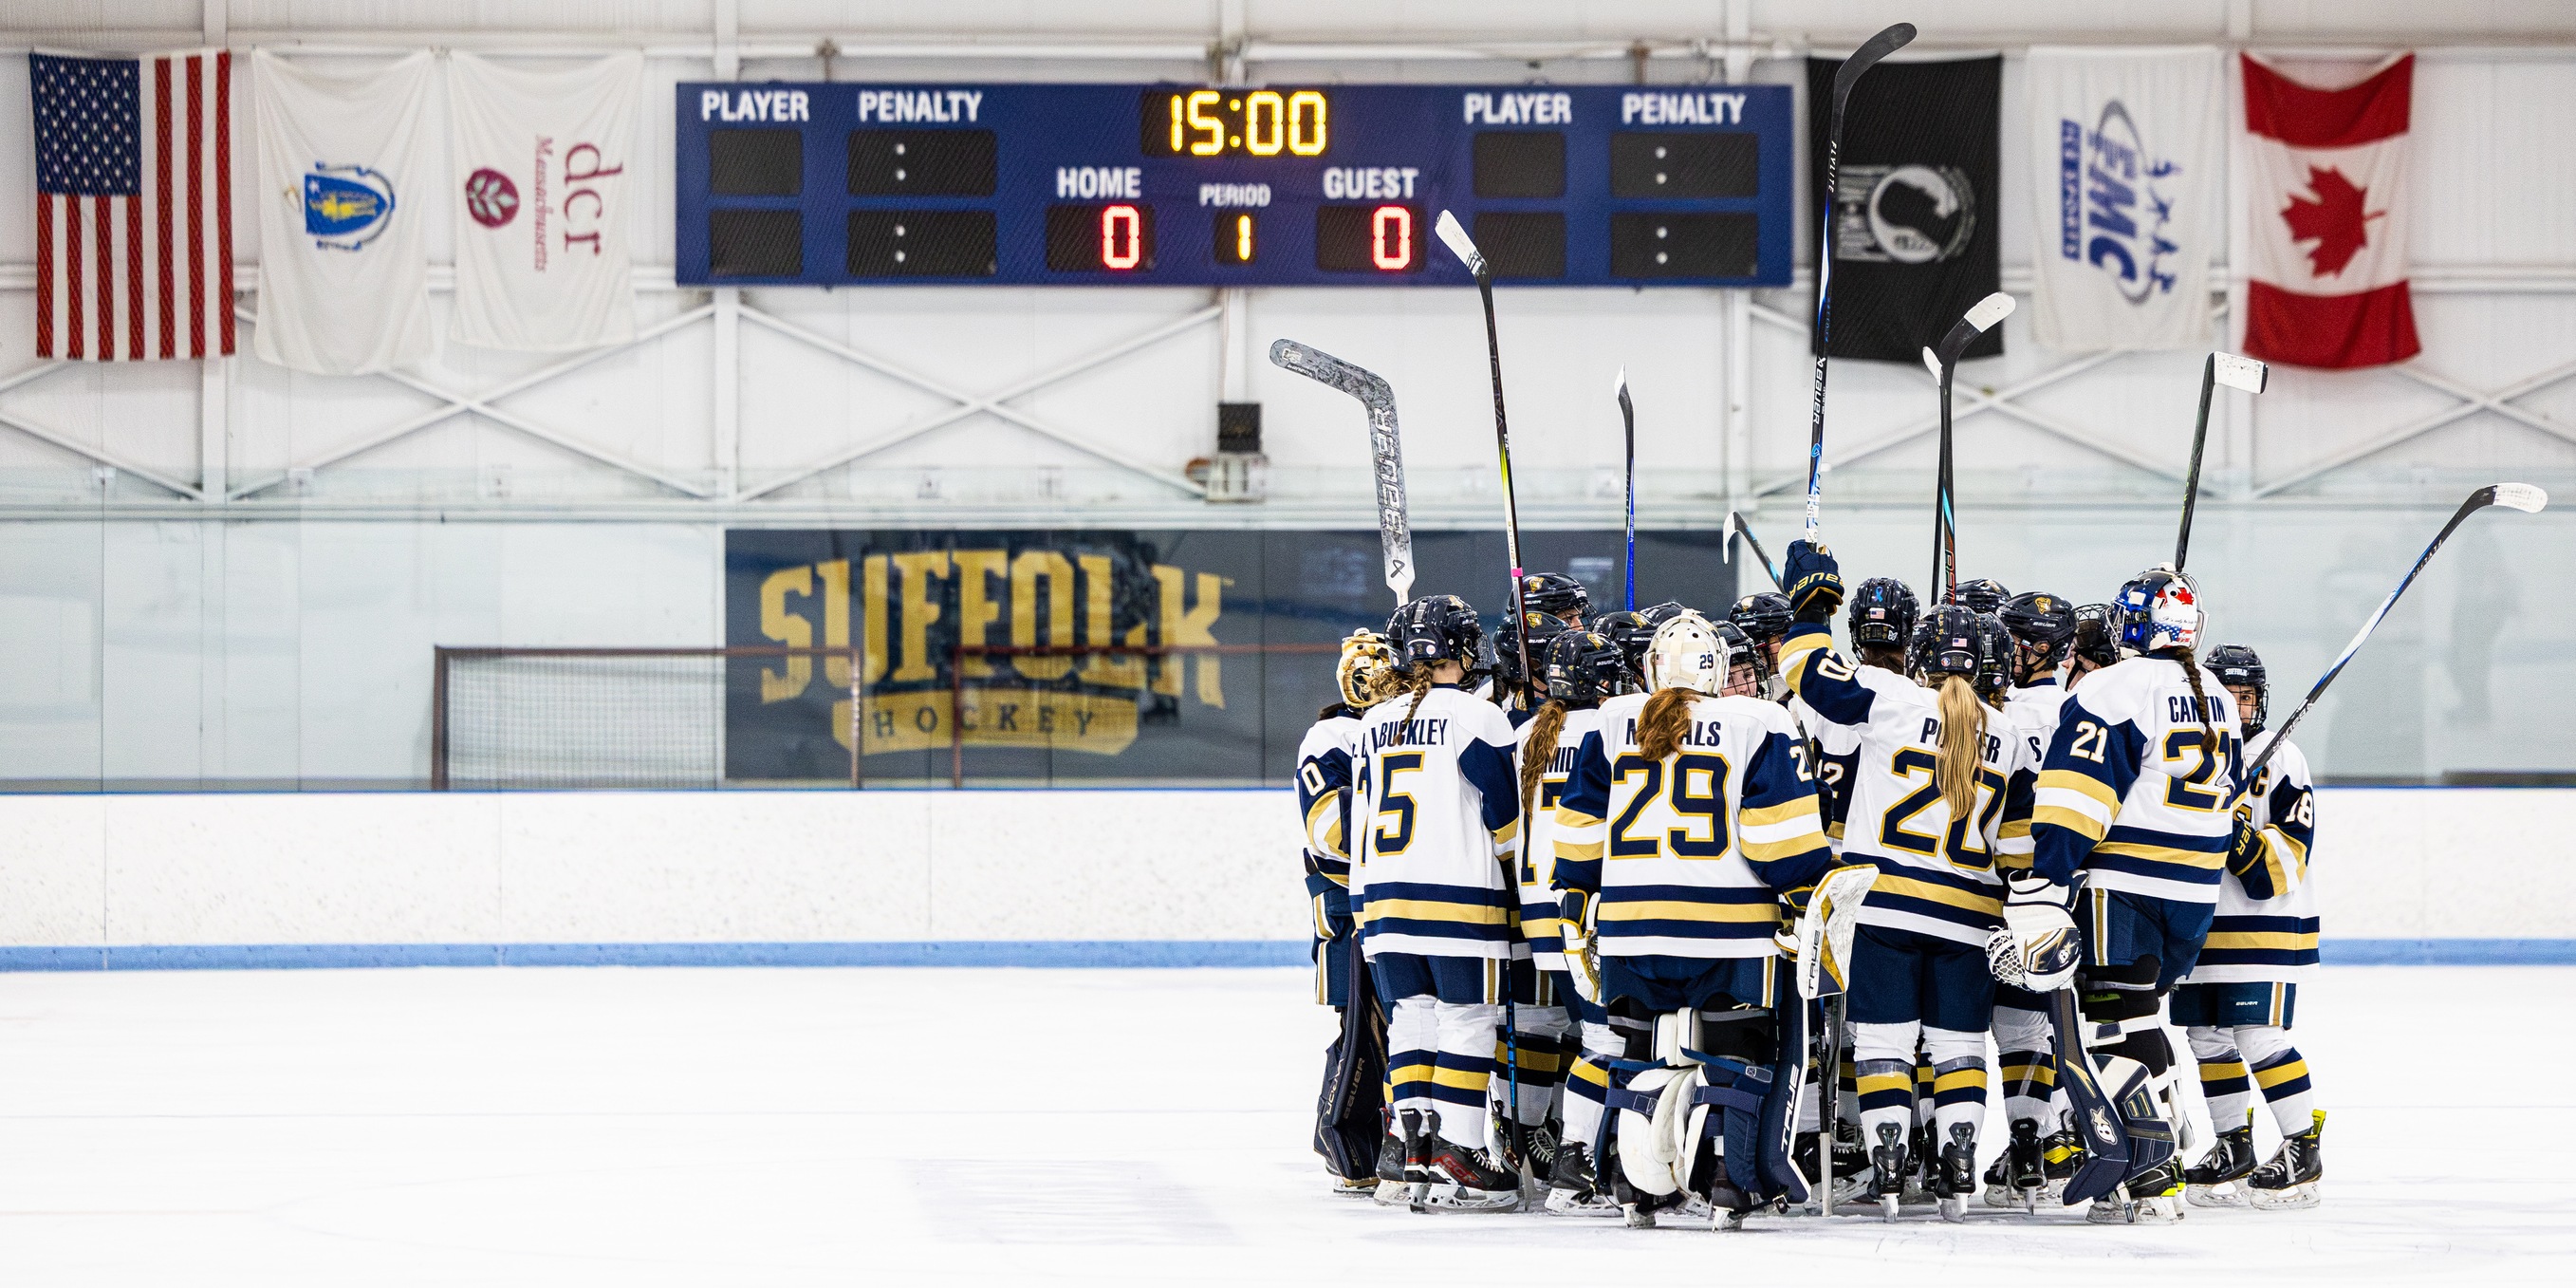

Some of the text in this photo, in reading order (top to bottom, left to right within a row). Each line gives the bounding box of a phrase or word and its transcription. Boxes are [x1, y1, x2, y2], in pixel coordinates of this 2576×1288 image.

[701, 91, 809, 121] PLAYER
[859, 92, 982, 121] PENALTY
[1169, 90, 1326, 157] 15:00
[1464, 93, 1572, 124] PLAYER
[1622, 93, 1747, 124] PENALTY
[1057, 168, 1141, 198] HOME
[1323, 167, 1418, 199] GUEST
[1828, 140, 1838, 193] FLYLITE
[564, 142, 623, 256] dcr
[1198, 182, 1271, 207] PERIOD
[1101, 204, 1140, 271] 0
[1236, 214, 1251, 262] 1
[1372, 205, 1412, 271] 0
[1812, 369, 1824, 425] BAUER
[1374, 407, 1404, 535] BAUER
[760, 550, 1226, 709] SUFFOLK
[1698, 653, 1714, 670] 29
[874, 705, 1095, 738] HOCKEY
[2069, 720, 2108, 764] 21
[2161, 728, 2232, 814] 21
[1608, 751, 1732, 861] 29
[1878, 745, 2009, 872] 20
[2285, 791, 2313, 830] 18
[1807, 928, 1821, 990] TRUE
[1343, 1056, 1366, 1121] BAUER
[1780, 1063, 1801, 1153] TRUE
